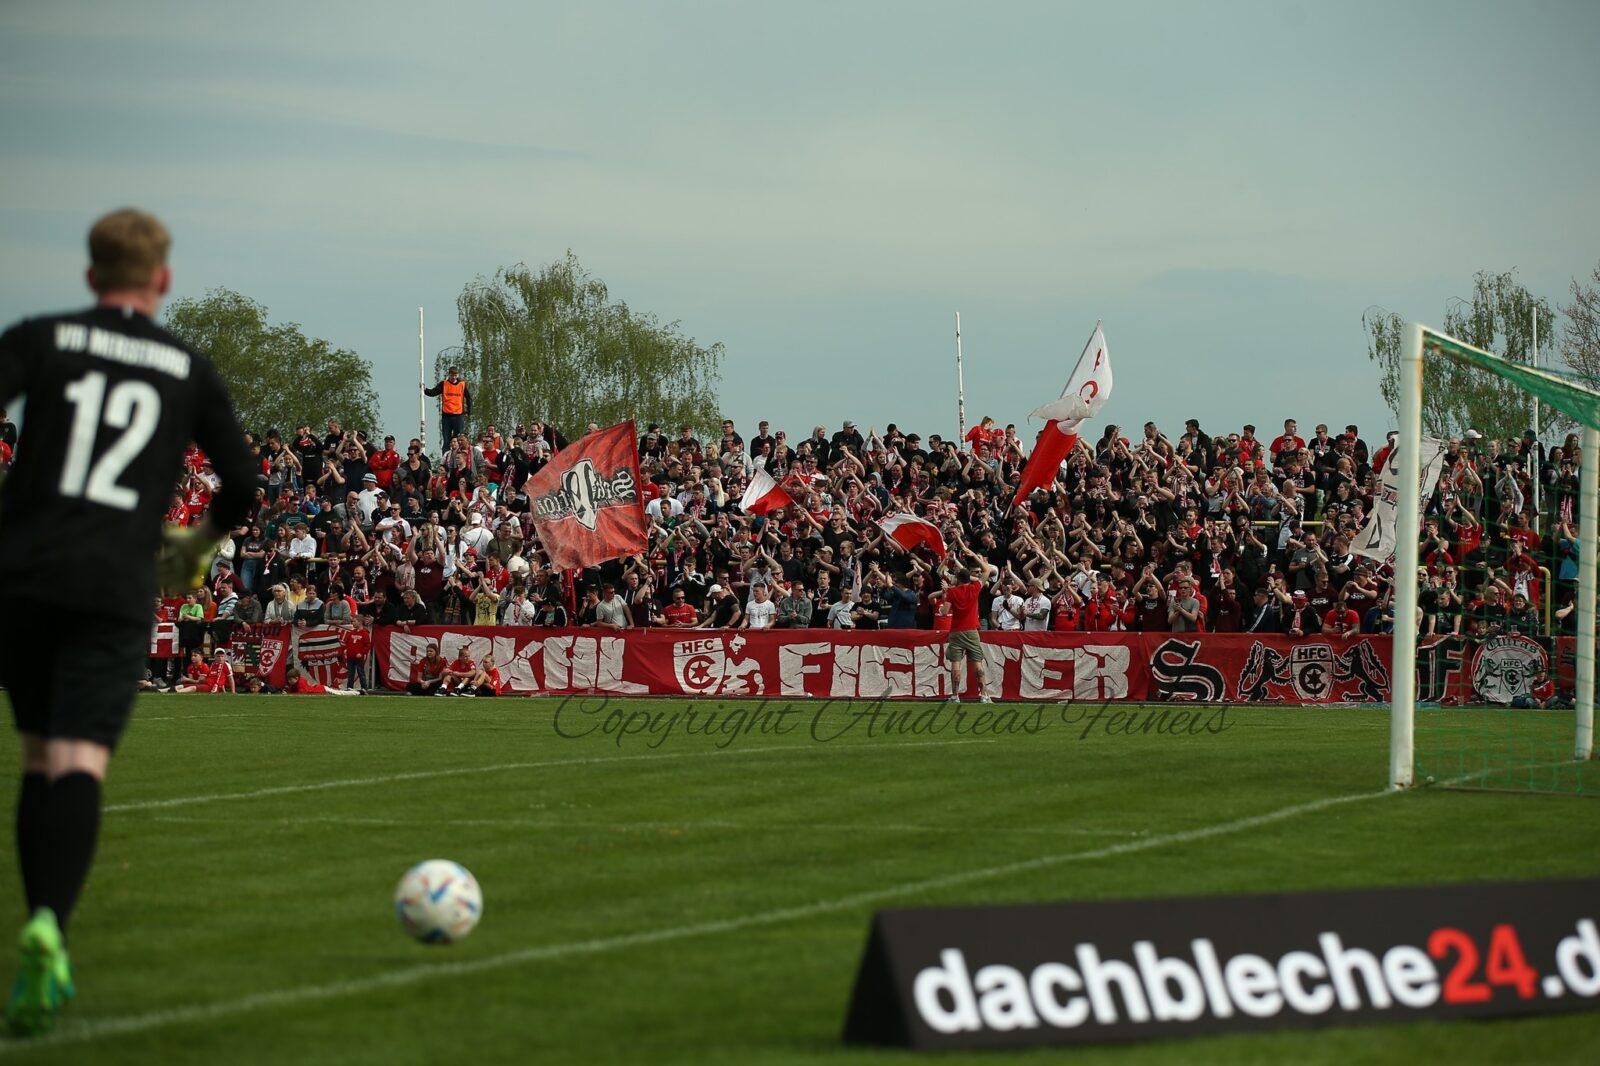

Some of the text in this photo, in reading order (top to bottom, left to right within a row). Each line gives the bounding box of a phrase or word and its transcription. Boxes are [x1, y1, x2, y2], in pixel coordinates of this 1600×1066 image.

[58, 371, 161, 510] 12
[682, 640, 714, 653] HFC
[778, 641, 1130, 700] FIGHTER
[1297, 648, 1328, 659] HFC
[913, 918, 1600, 1033] dachbleche24.d
